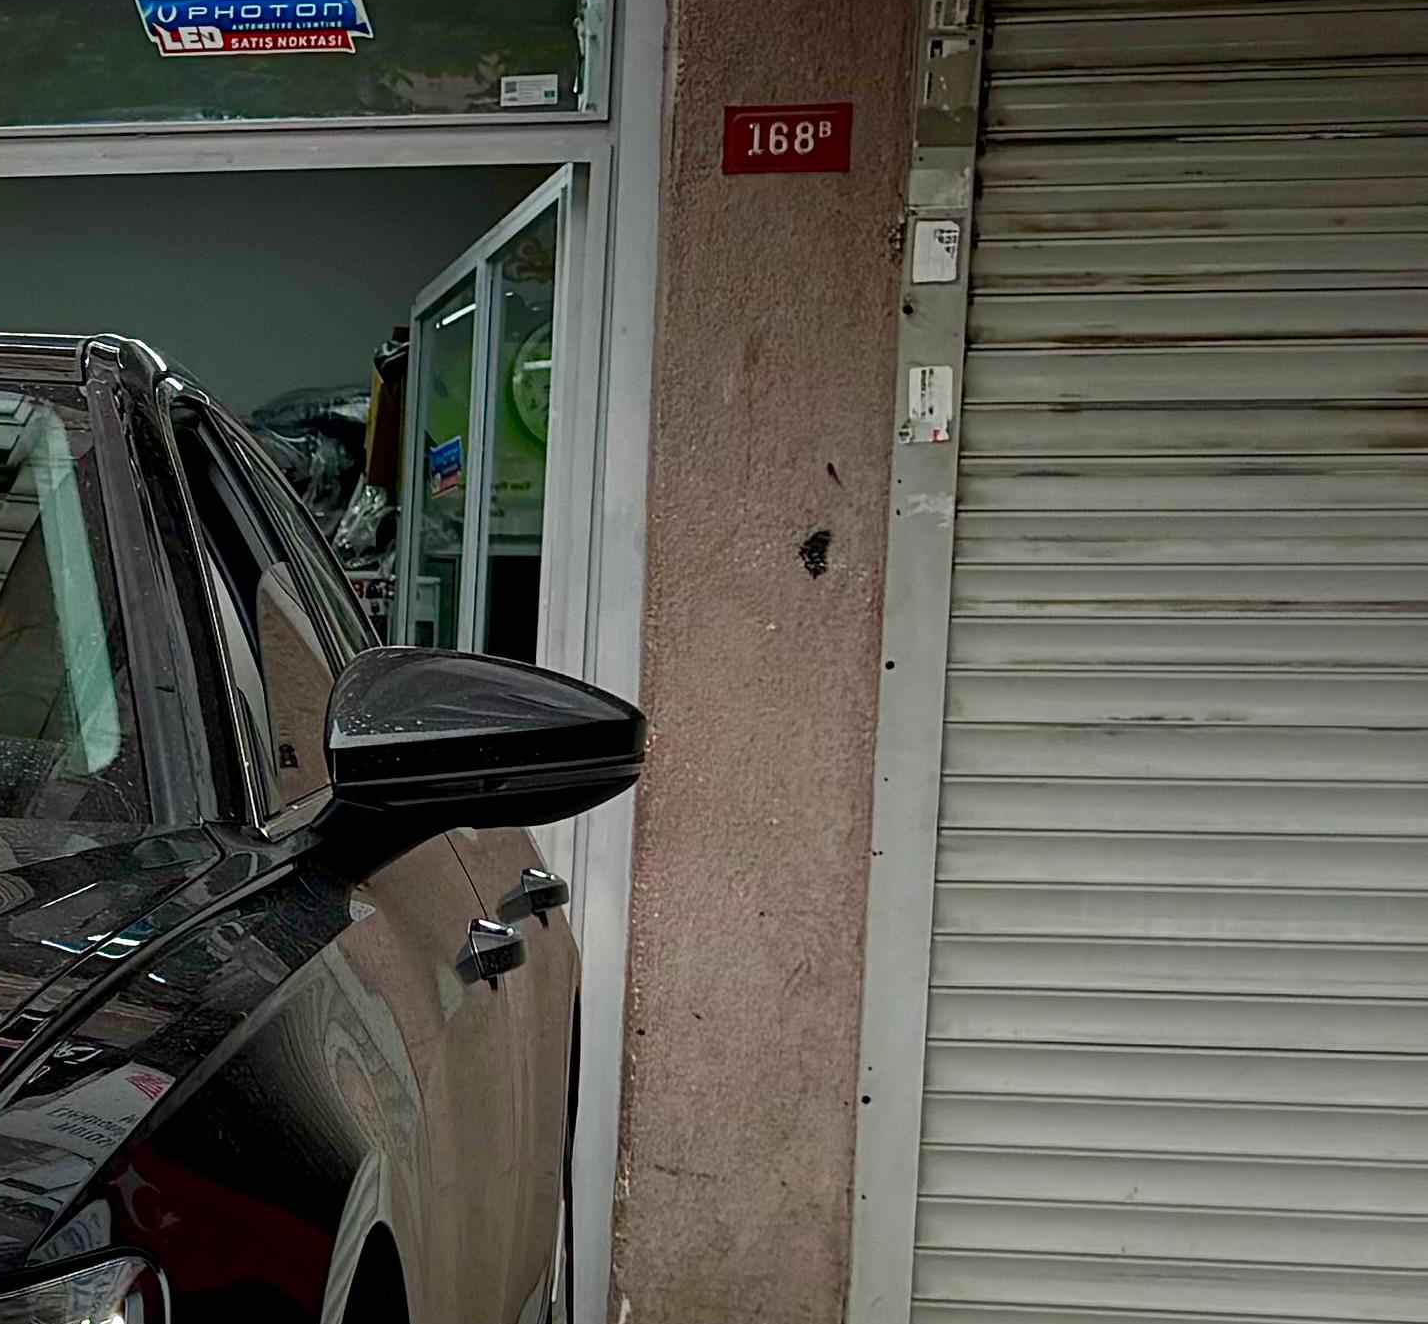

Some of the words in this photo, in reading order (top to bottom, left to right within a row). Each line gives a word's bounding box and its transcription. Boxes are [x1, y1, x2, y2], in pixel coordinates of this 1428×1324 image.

[188, 2, 343, 20] PHOTON
[154, 25, 224, 51] LED
[277, 35, 343, 48] NOKTASI
